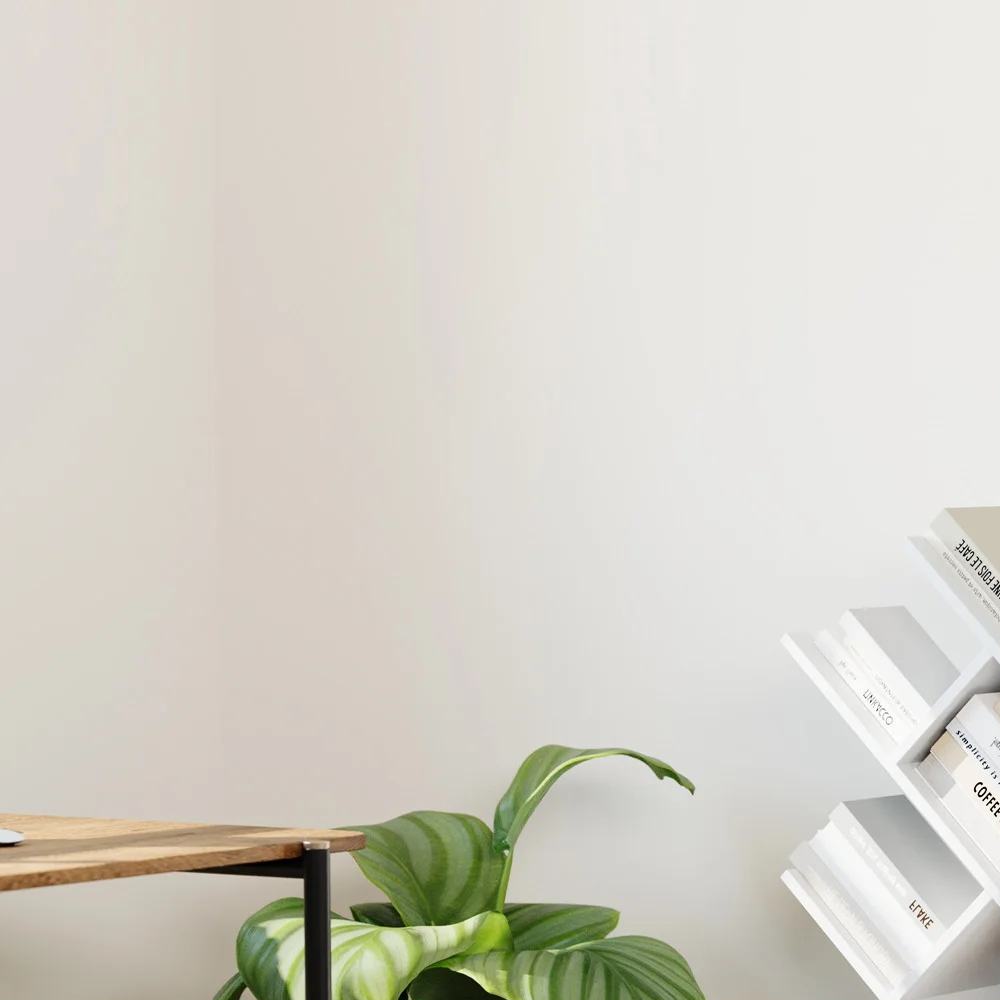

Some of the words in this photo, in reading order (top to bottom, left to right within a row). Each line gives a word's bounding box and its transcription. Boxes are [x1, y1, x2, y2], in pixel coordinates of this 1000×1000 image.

[954, 538, 975, 562] CAFÉ
[969, 555, 983, 571] LE
[977, 565, 995, 586] FOIS
[955, 730, 991, 771] simplicity
[990, 770, 998, 780] is
